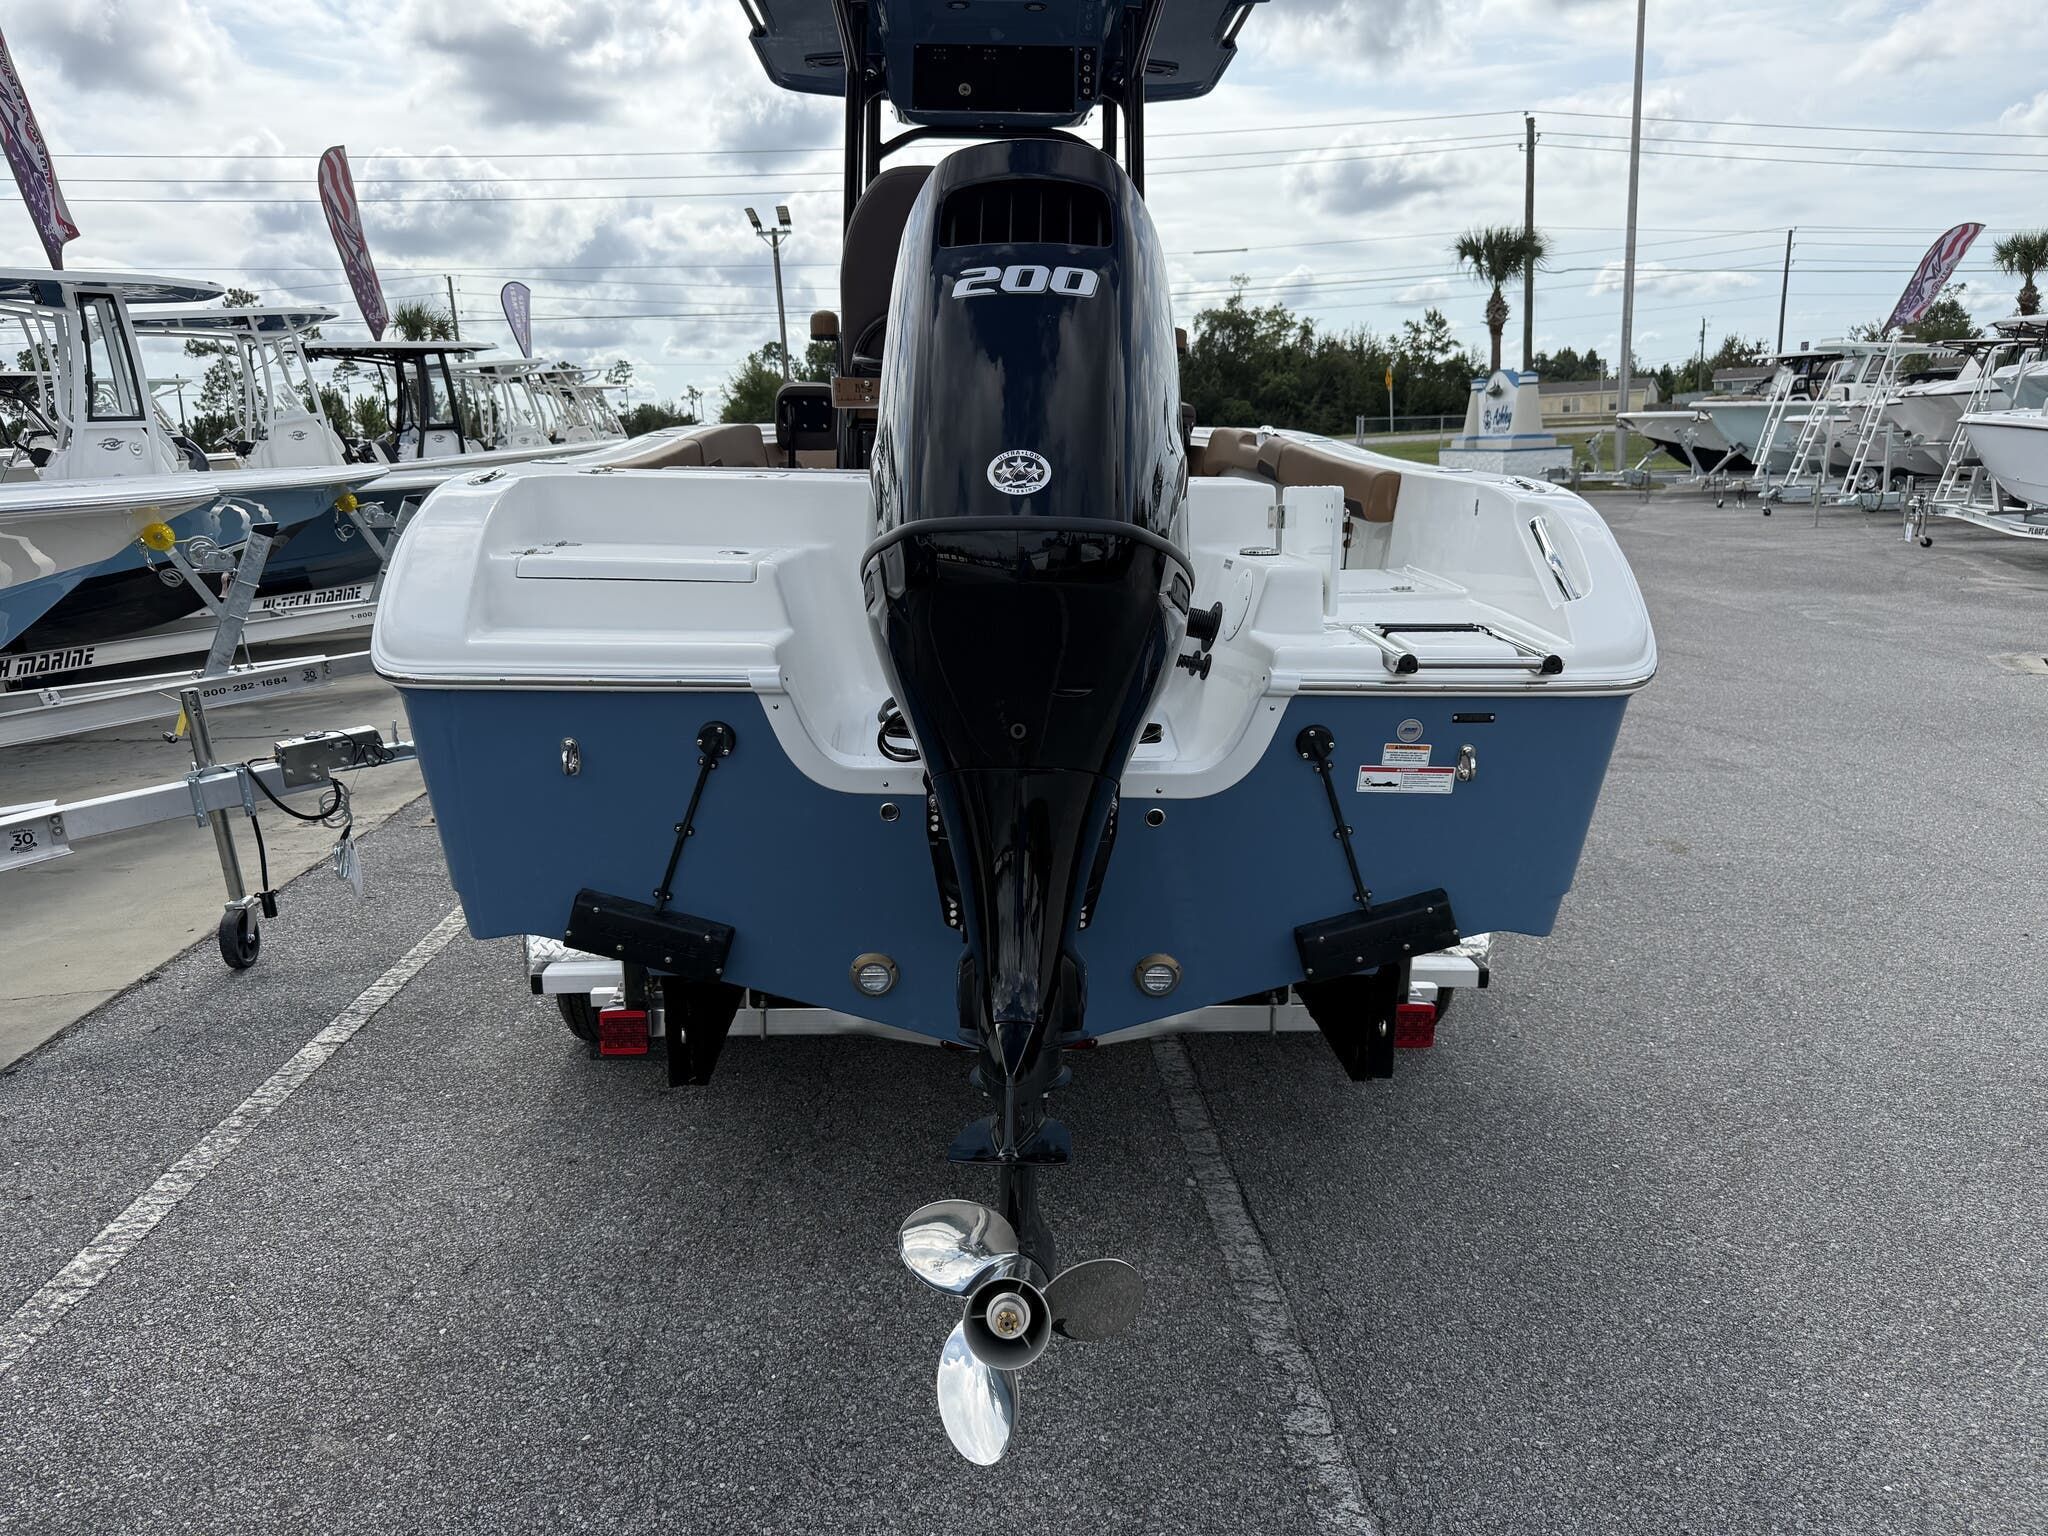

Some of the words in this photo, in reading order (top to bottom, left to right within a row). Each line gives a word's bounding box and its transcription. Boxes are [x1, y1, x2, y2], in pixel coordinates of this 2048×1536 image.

[952, 265, 1099, 299] 200
[314, 586, 361, 603] MARINE
[17, 647, 95, 676] MARINE
[304, 670, 316, 679] 30
[13, 833, 33, 847] 30
